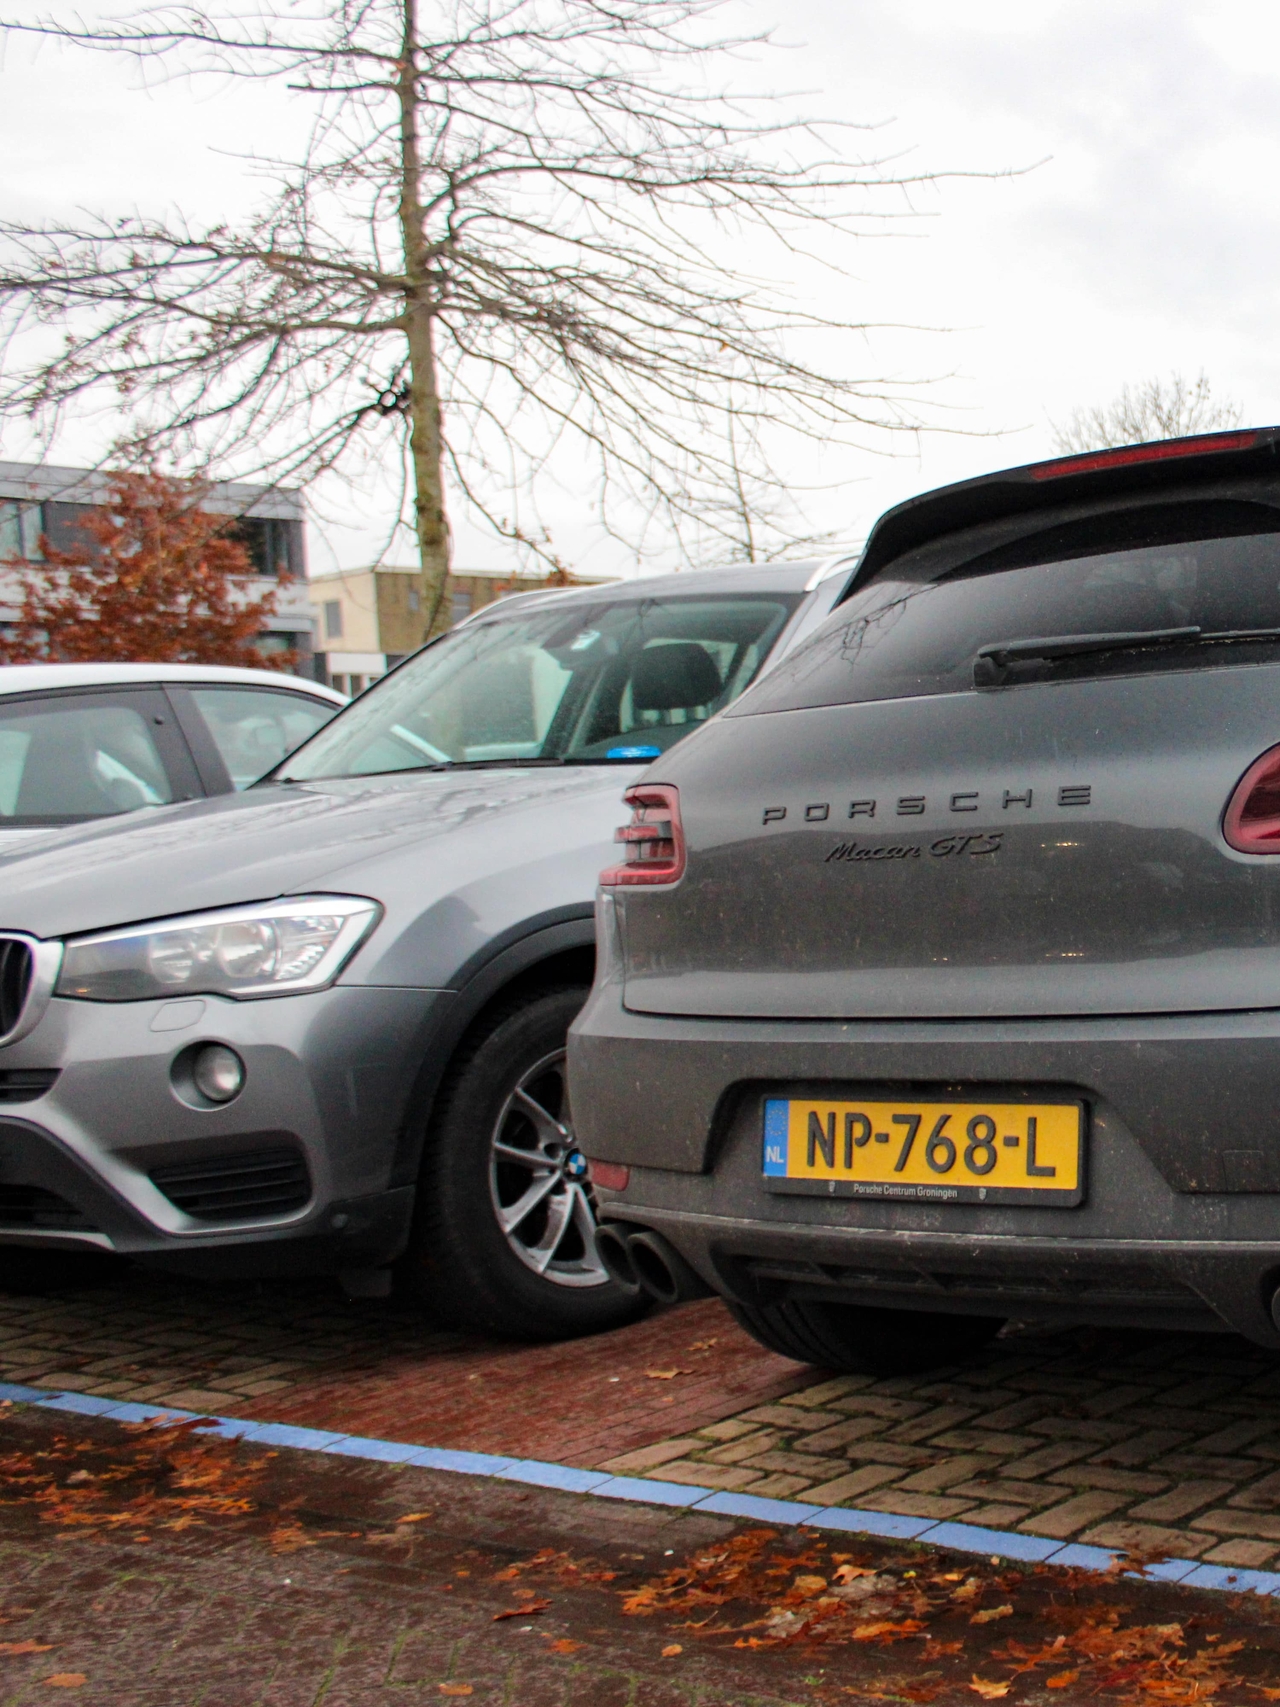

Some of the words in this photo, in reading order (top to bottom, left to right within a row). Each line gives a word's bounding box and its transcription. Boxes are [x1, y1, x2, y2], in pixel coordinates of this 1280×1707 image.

[762, 785, 1091, 825] PORSCHE
[824, 841, 920, 862] Macan
[931, 833, 1004, 858] GTS
[766, 1146, 785, 1165] NL
[807, 1110, 1056, 1178] NP-768-L
[853, 1183, 882, 1195] Porsche
[884, 1185, 916, 1197] Centrum
[917, 1186, 958, 1200] Groningen
